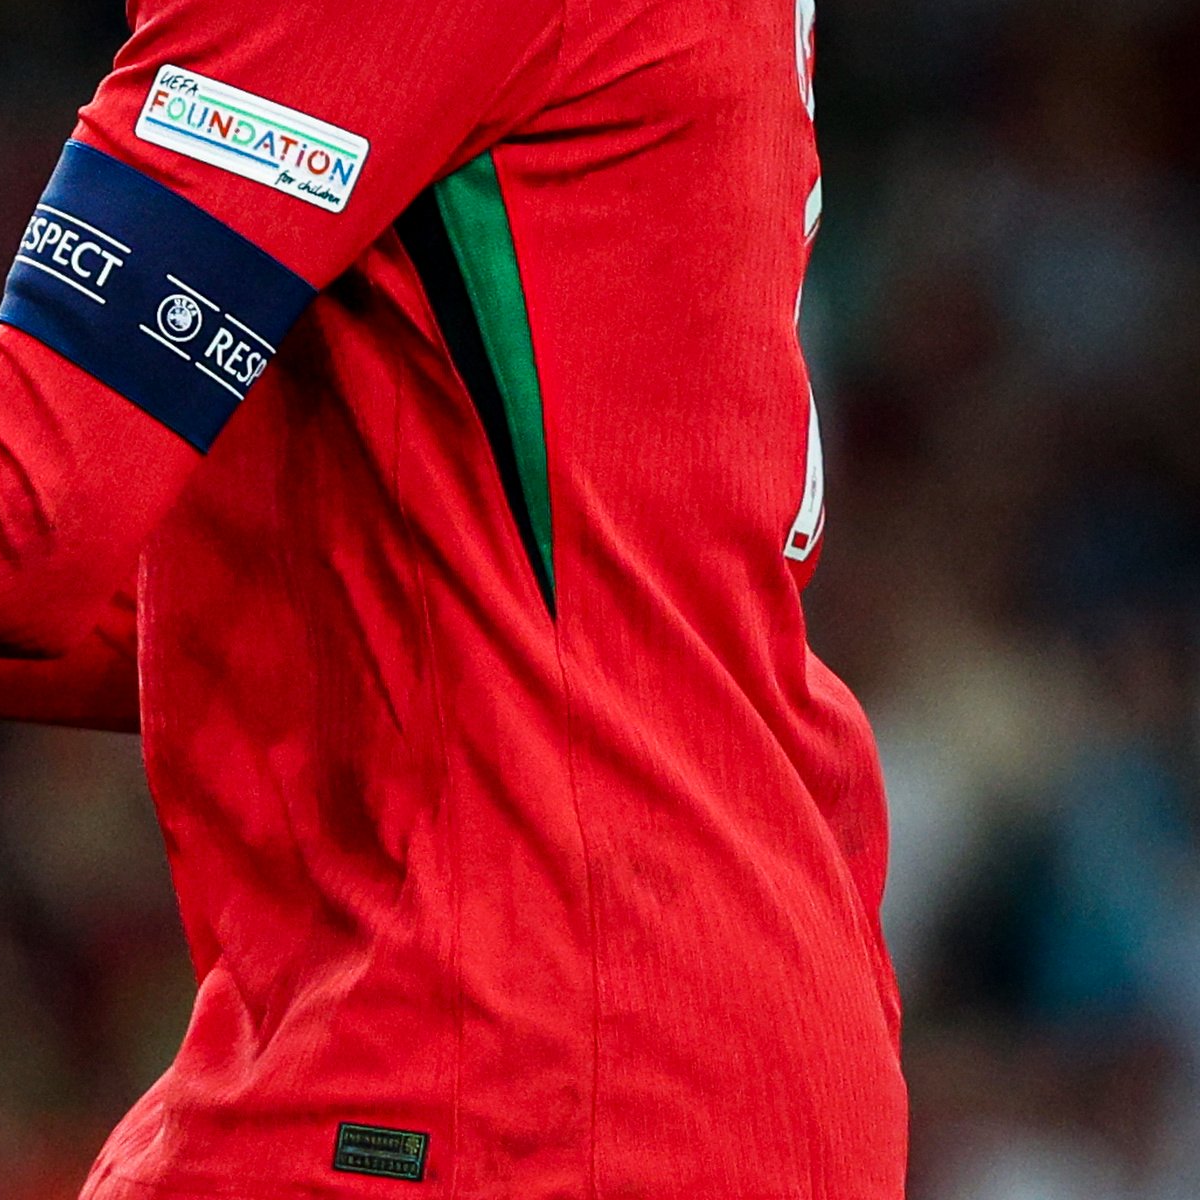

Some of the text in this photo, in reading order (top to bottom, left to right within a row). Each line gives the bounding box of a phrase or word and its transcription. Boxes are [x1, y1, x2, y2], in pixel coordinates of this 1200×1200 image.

[160, 71, 198, 96] UEFA
[274, 169, 341, 205] for children
